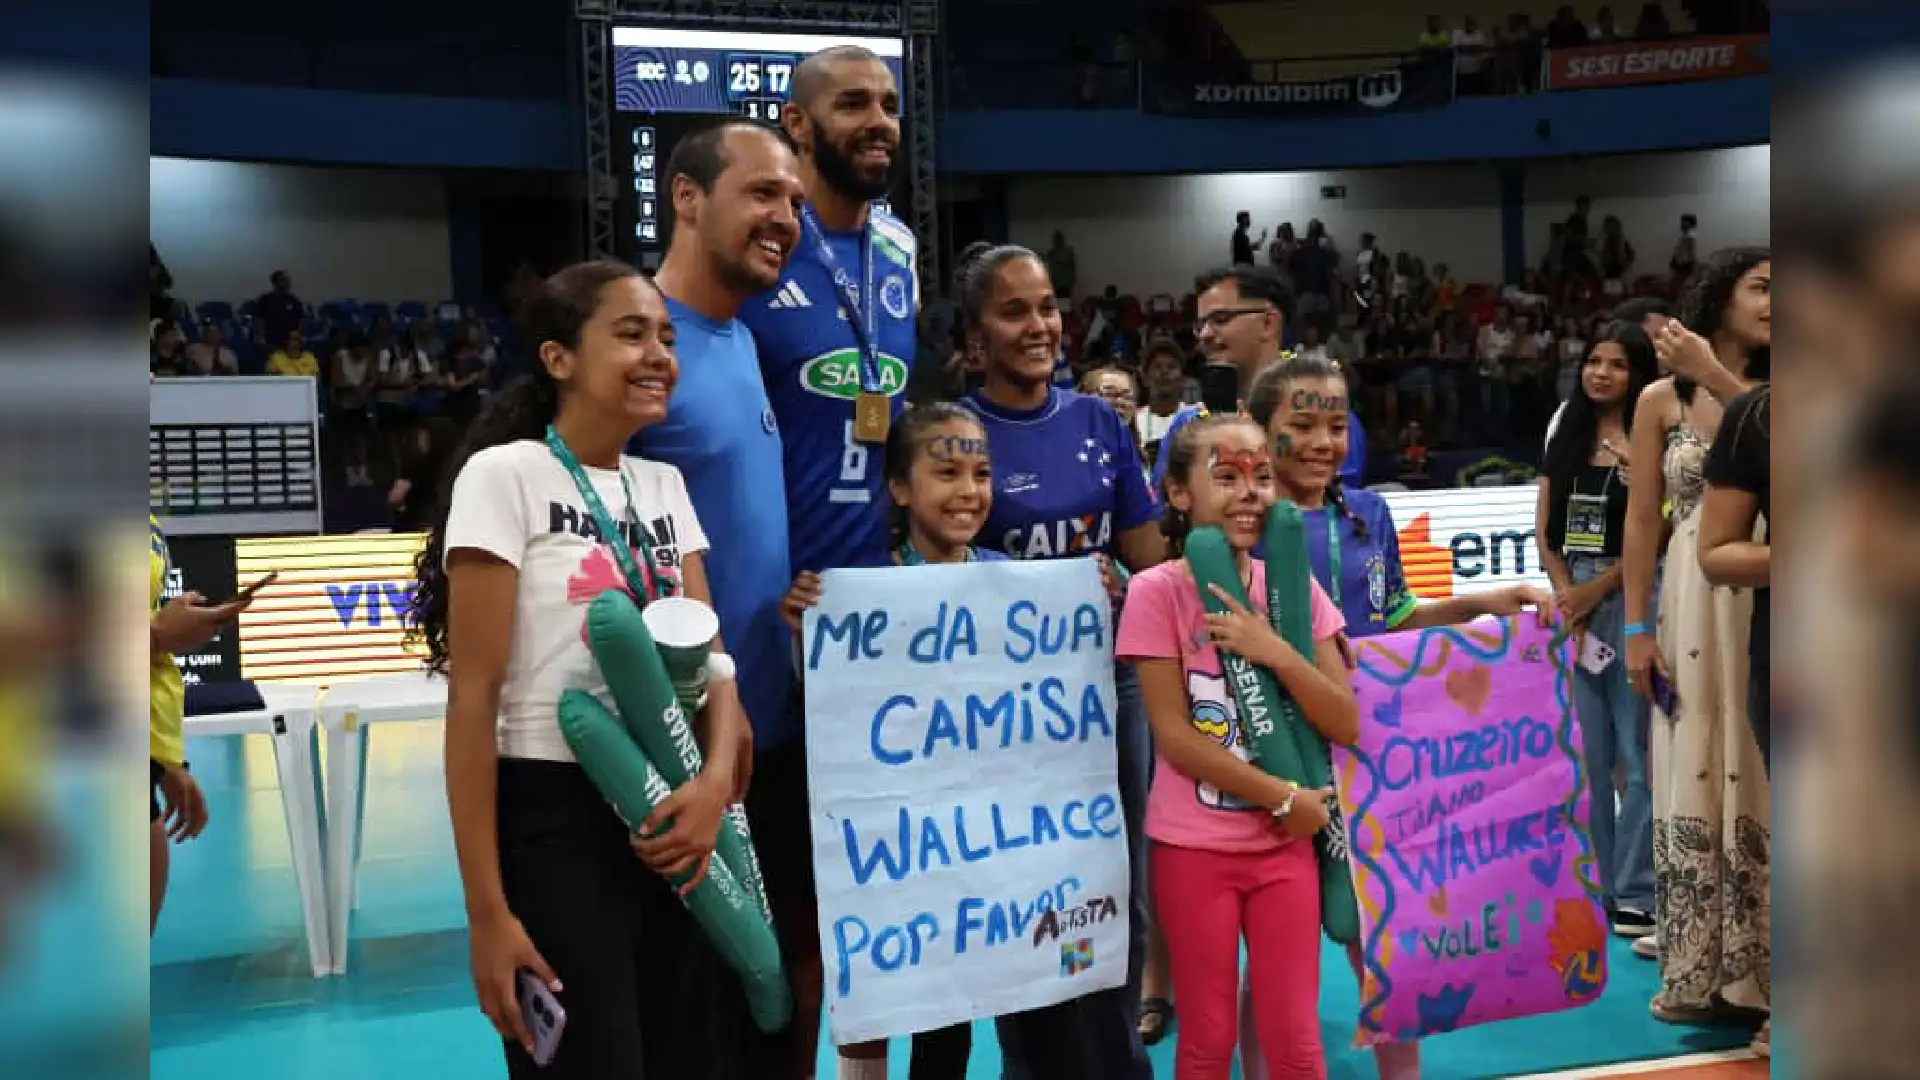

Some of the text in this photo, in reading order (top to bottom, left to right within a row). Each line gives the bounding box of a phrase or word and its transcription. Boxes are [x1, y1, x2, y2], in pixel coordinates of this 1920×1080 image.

[767, 64, 792, 93] 17
[1624, 44, 1736, 75] ESPORTE
[820, 362, 896, 388] SAA
[1002, 511, 1112, 559] CAIXA
[808, 608, 888, 670] Me
[1231, 658, 1275, 738] SENAR
